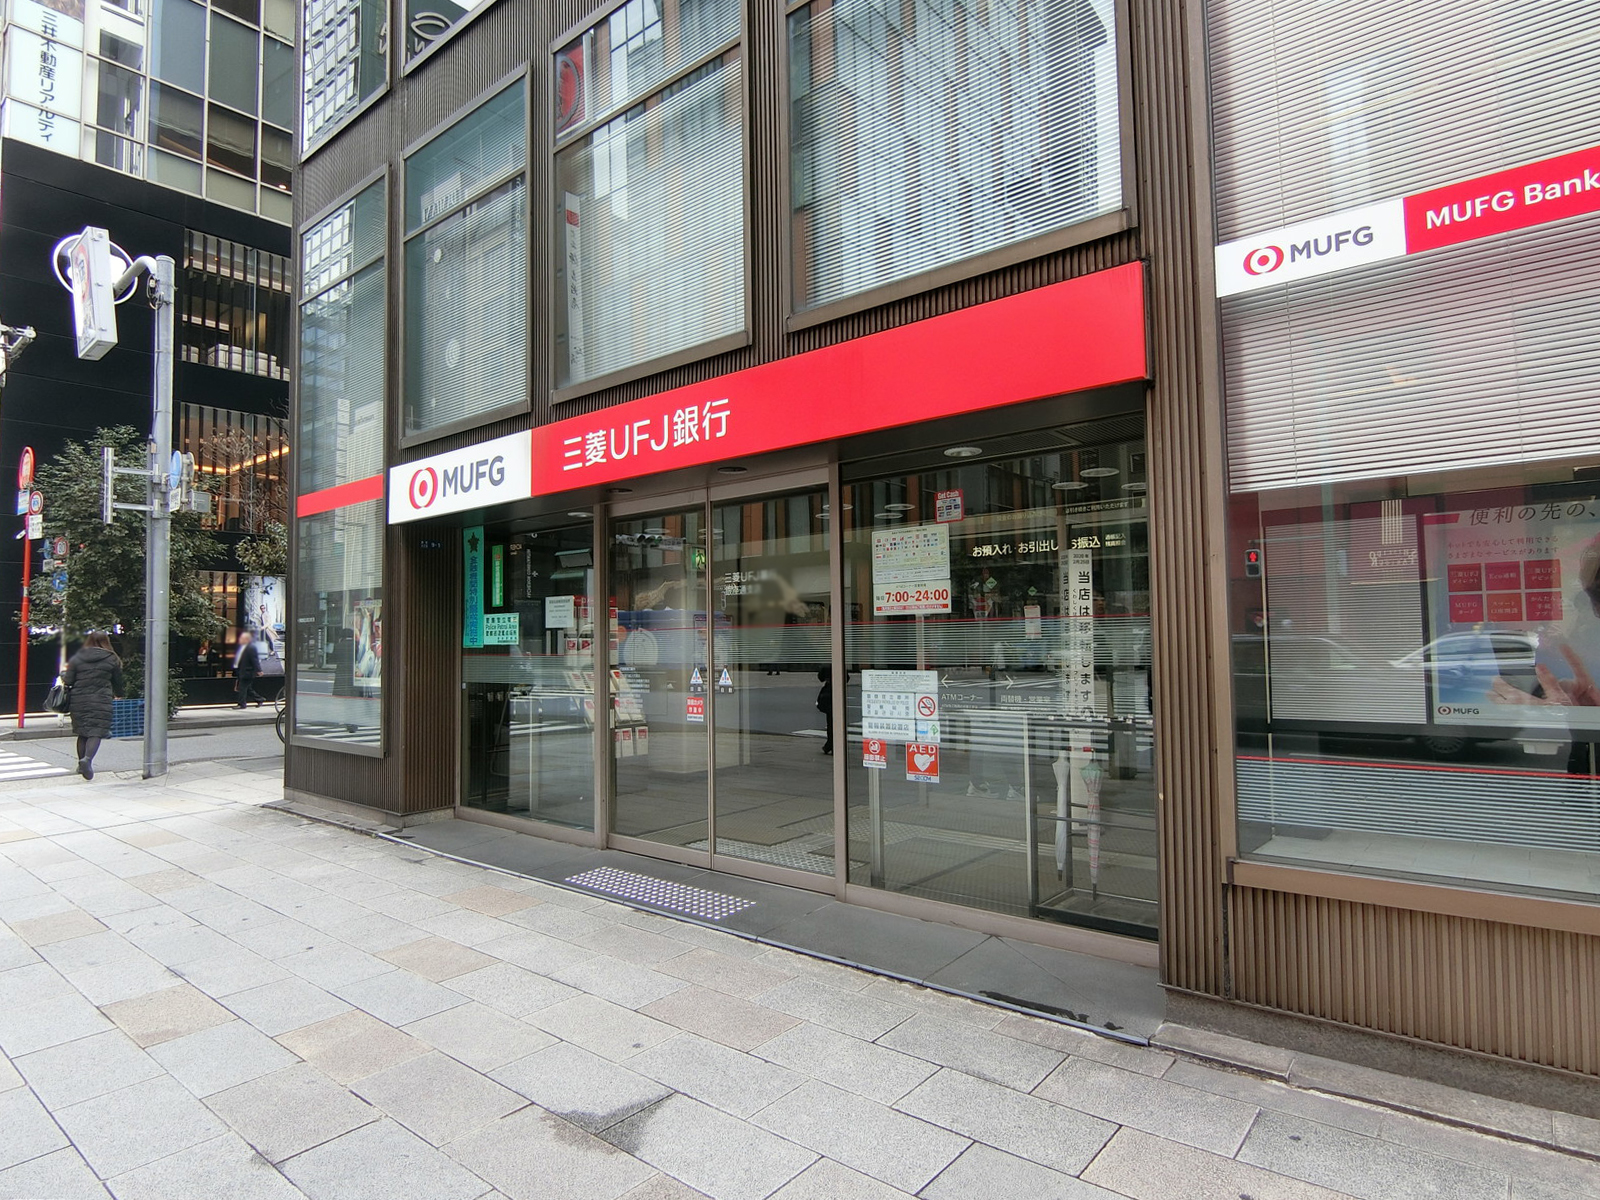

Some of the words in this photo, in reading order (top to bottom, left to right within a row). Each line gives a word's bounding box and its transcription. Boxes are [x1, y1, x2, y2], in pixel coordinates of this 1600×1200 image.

[38, 10, 58, 142] 三井不動産リアルティ
[1425, 190, 1515, 230] MUFG
[1524, 168, 1600, 206] Bank
[1290, 225, 1373, 263] MUFG
[562, 398, 731, 472] 三菱UFJ銀行
[442, 454, 504, 497] MUFG
[1470, 502, 1596, 526] 便利の先の、
[941, 693, 983, 701] ATMコーナー
[909, 744, 936, 754] AED
